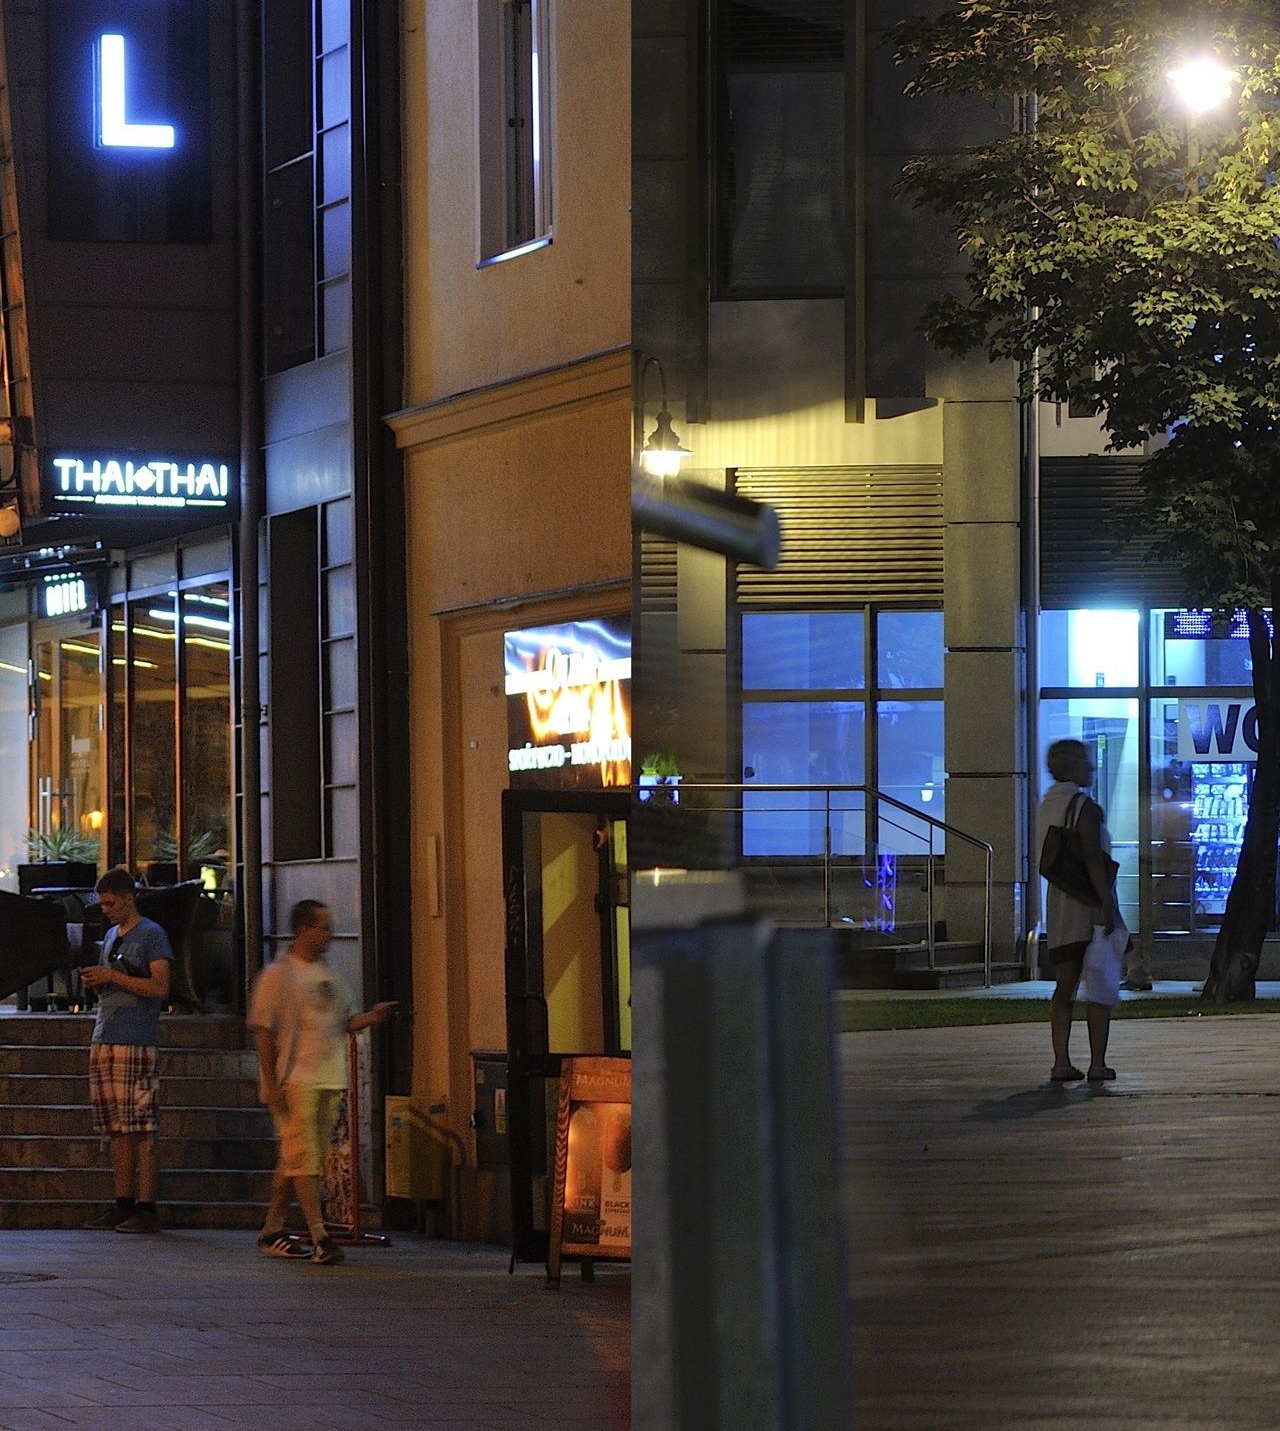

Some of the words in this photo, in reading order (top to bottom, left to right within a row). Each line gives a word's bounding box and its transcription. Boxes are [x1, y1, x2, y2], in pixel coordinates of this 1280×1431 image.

[53, 458, 134, 493] THAI
[148, 462, 228, 497] THAI
[604, 1199, 630, 1208] BLACK
